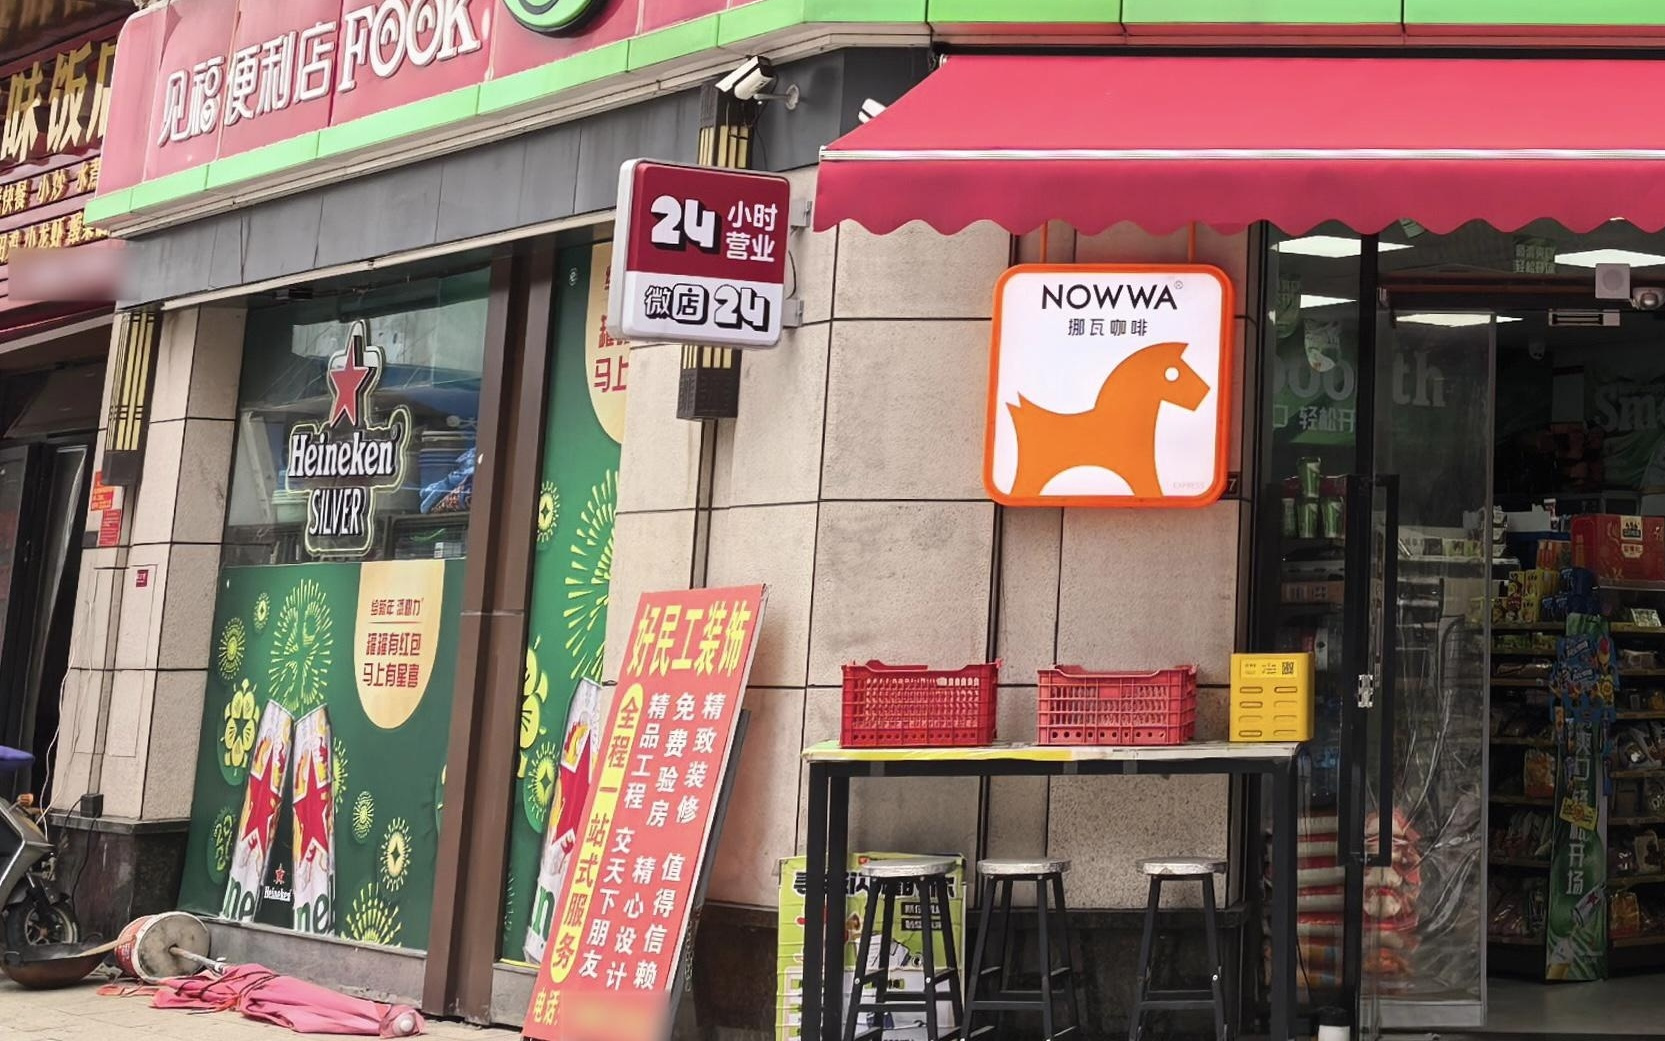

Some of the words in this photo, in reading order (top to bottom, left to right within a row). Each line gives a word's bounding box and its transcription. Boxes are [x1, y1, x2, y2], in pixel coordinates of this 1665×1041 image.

[158, 20, 337, 147] 见福便利店
[651, 194, 722, 254] 24
[727, 200, 778, 232] 小时
[725, 231, 775, 263] 营业
[645, 284, 710, 324] 微店
[713, 283, 771, 333] 24
[1041, 283, 1178, 310] NOWWA
[1067, 318, 1148, 337] 挪瓦咖啡
[593, 355, 630, 393] 马上
[288, 429, 398, 478] Heineken
[309, 487, 363, 536] SILVER
[626, 600, 752, 679] 好民工装饰
[363, 662, 420, 689] 马上有星喜
[623, 692, 672, 810] 精品工程
[645, 691, 697, 828] 免费验房
[676, 691, 727, 824] 精致装修
[552, 696, 640, 970] 全程一站式服务
[578, 826, 636, 980] 交天下朋友
[605, 855, 657, 991] 精心设计
[632, 852, 686, 991] 值得信赖
